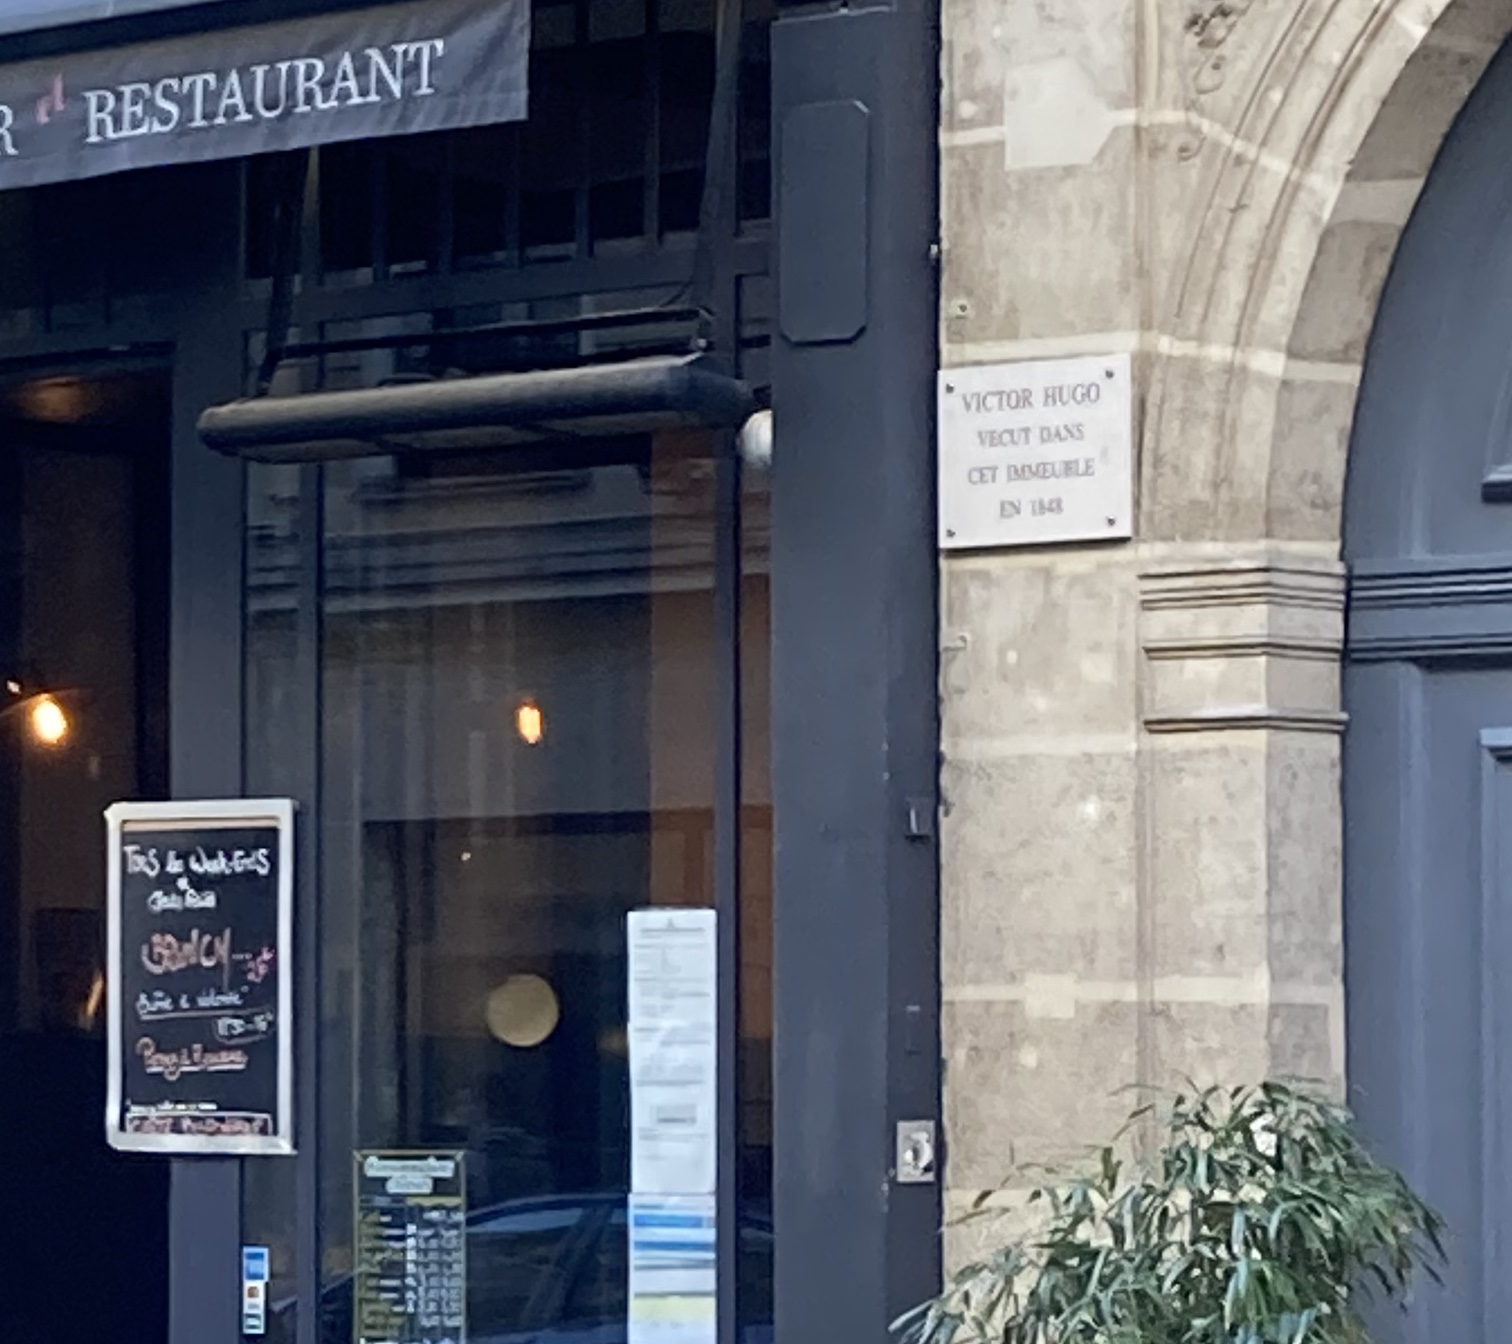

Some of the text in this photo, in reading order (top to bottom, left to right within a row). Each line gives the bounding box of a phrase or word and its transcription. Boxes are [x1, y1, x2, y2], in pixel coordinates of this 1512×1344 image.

[85, 38, 446, 144] RESTAURANT
[961, 382, 1101, 414] VICTOR HUGO
[977, 424, 1085, 448] VECUT DANS
[967, 458, 1095, 486] CET IMMEUBLE
[999, 500, 1022, 519] EN
